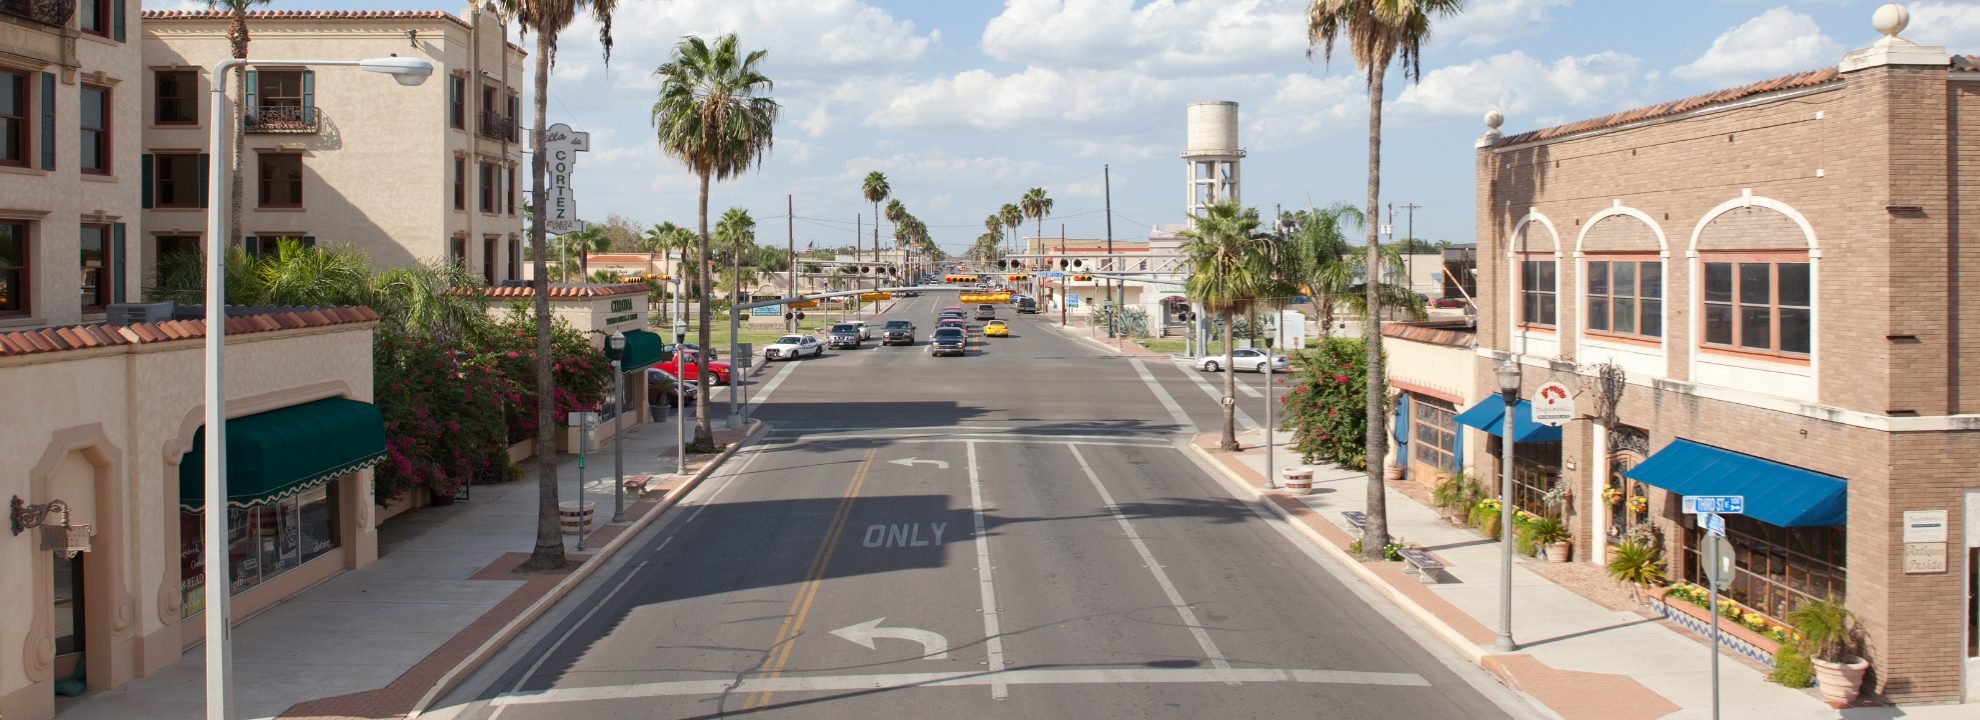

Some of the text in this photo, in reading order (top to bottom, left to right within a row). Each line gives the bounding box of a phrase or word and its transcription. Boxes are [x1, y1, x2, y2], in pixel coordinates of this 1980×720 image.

[546, 132, 567, 142] illa
[555, 150, 566, 219] CORTEZ
[1697, 498, 1715, 512] THIRD
[862, 522, 948, 548] ONLY
[1907, 559, 1943, 571] Inside
